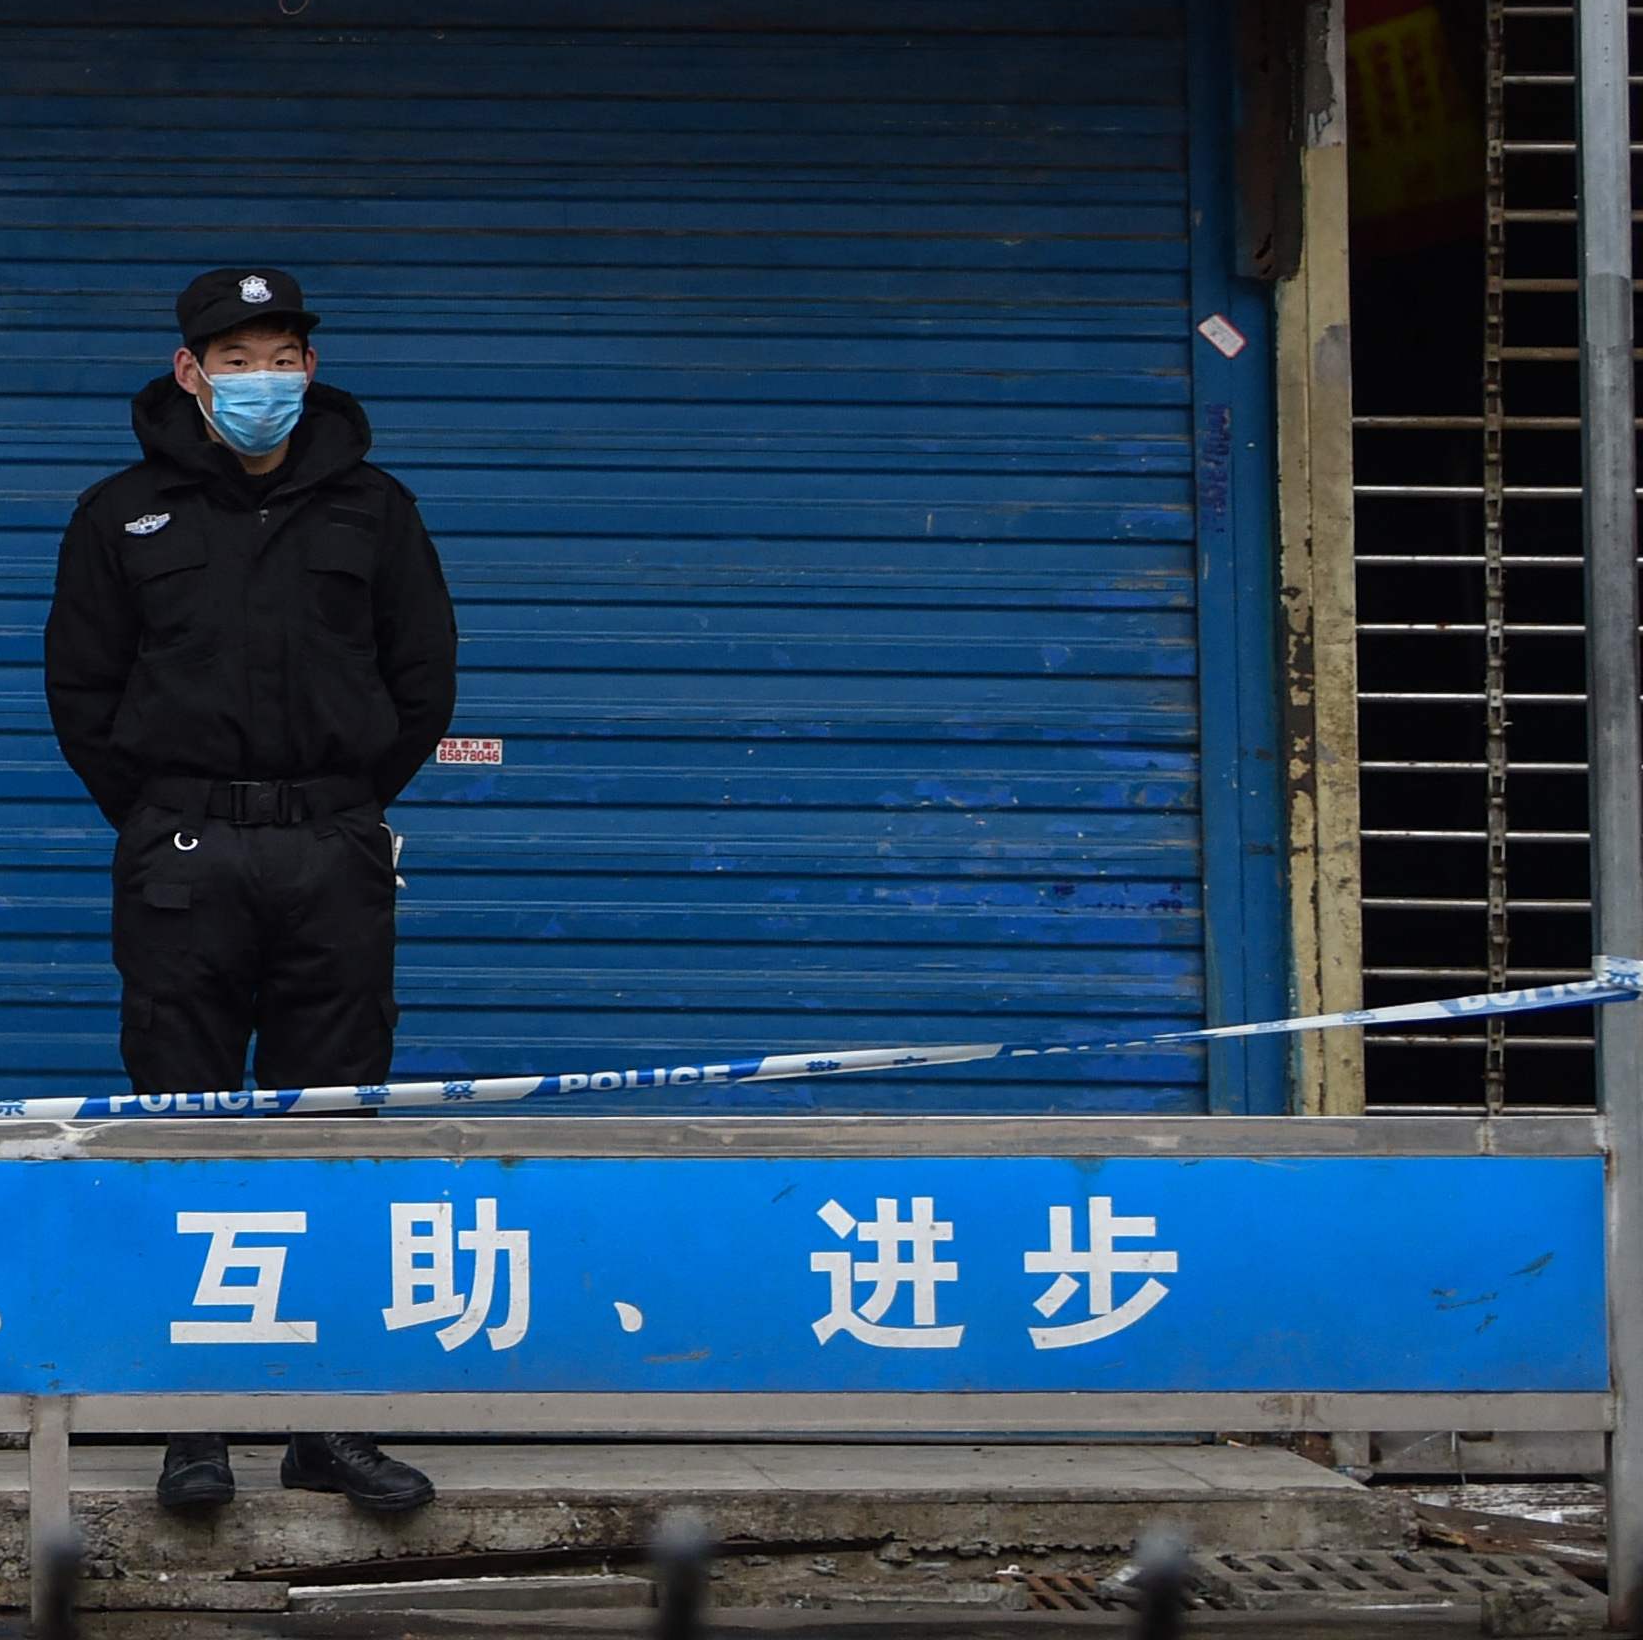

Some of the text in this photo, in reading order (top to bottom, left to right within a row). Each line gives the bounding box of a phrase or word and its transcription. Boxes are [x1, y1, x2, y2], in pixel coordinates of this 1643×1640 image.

[439, 749, 500, 762] 85878046
[109, 1090, 280, 1113] POLICE
[559, 1064, 731, 1094] POLICE
[811, 1196, 1178, 1350] 进步
